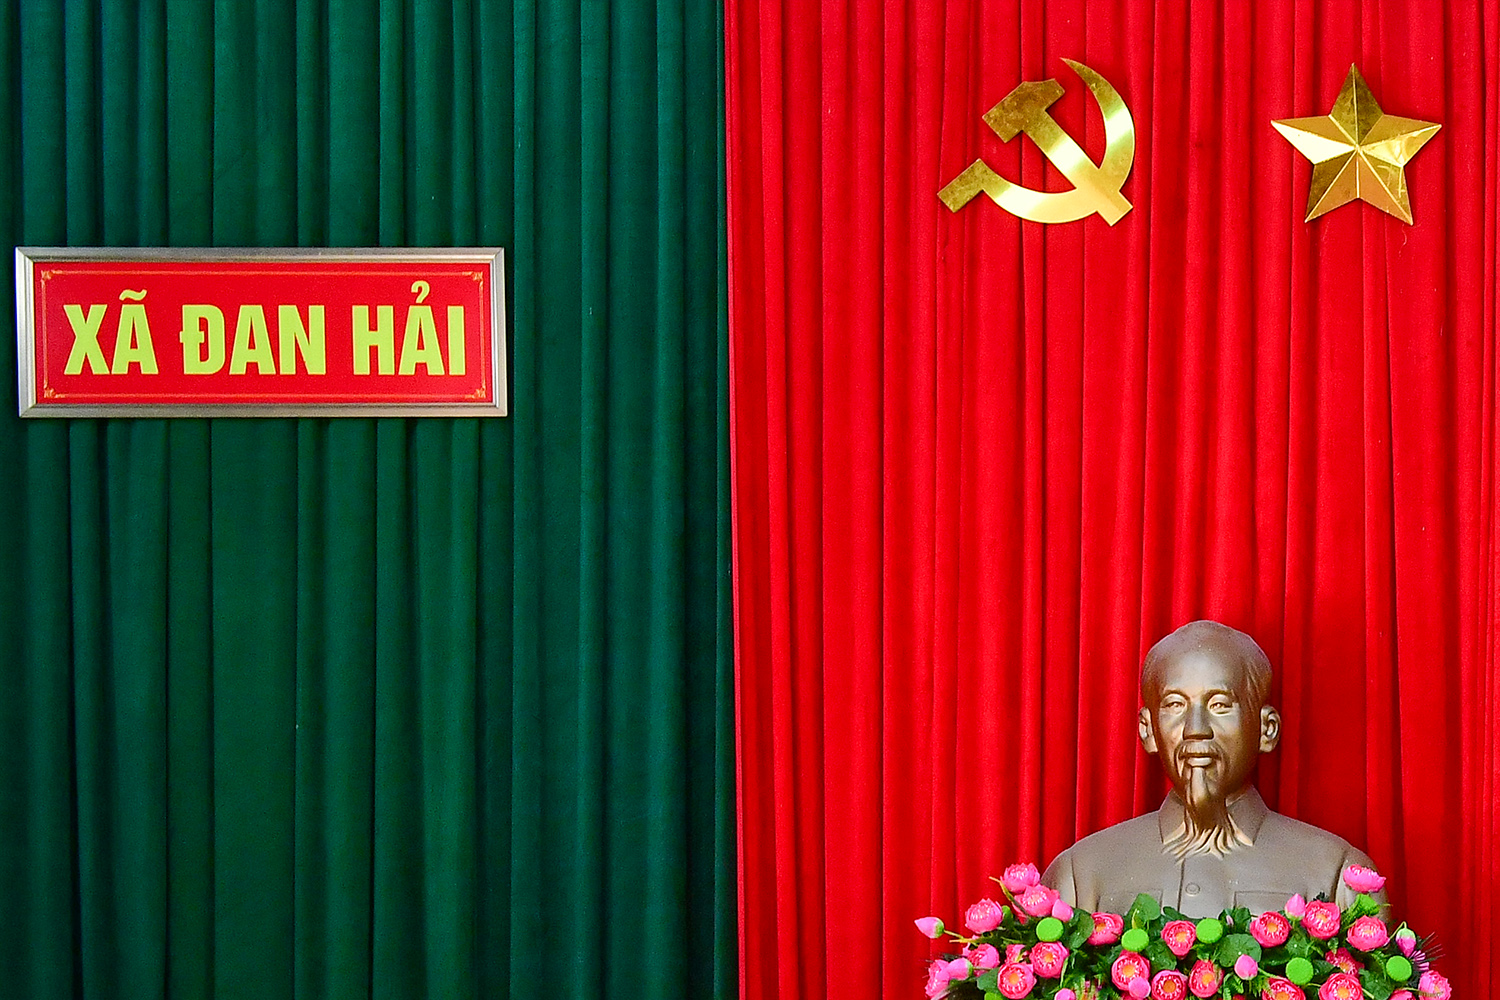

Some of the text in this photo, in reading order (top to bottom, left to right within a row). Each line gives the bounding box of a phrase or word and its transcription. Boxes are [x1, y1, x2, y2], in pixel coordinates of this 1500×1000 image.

[63, 280, 466, 376] XÃ ĐAN HẢI
